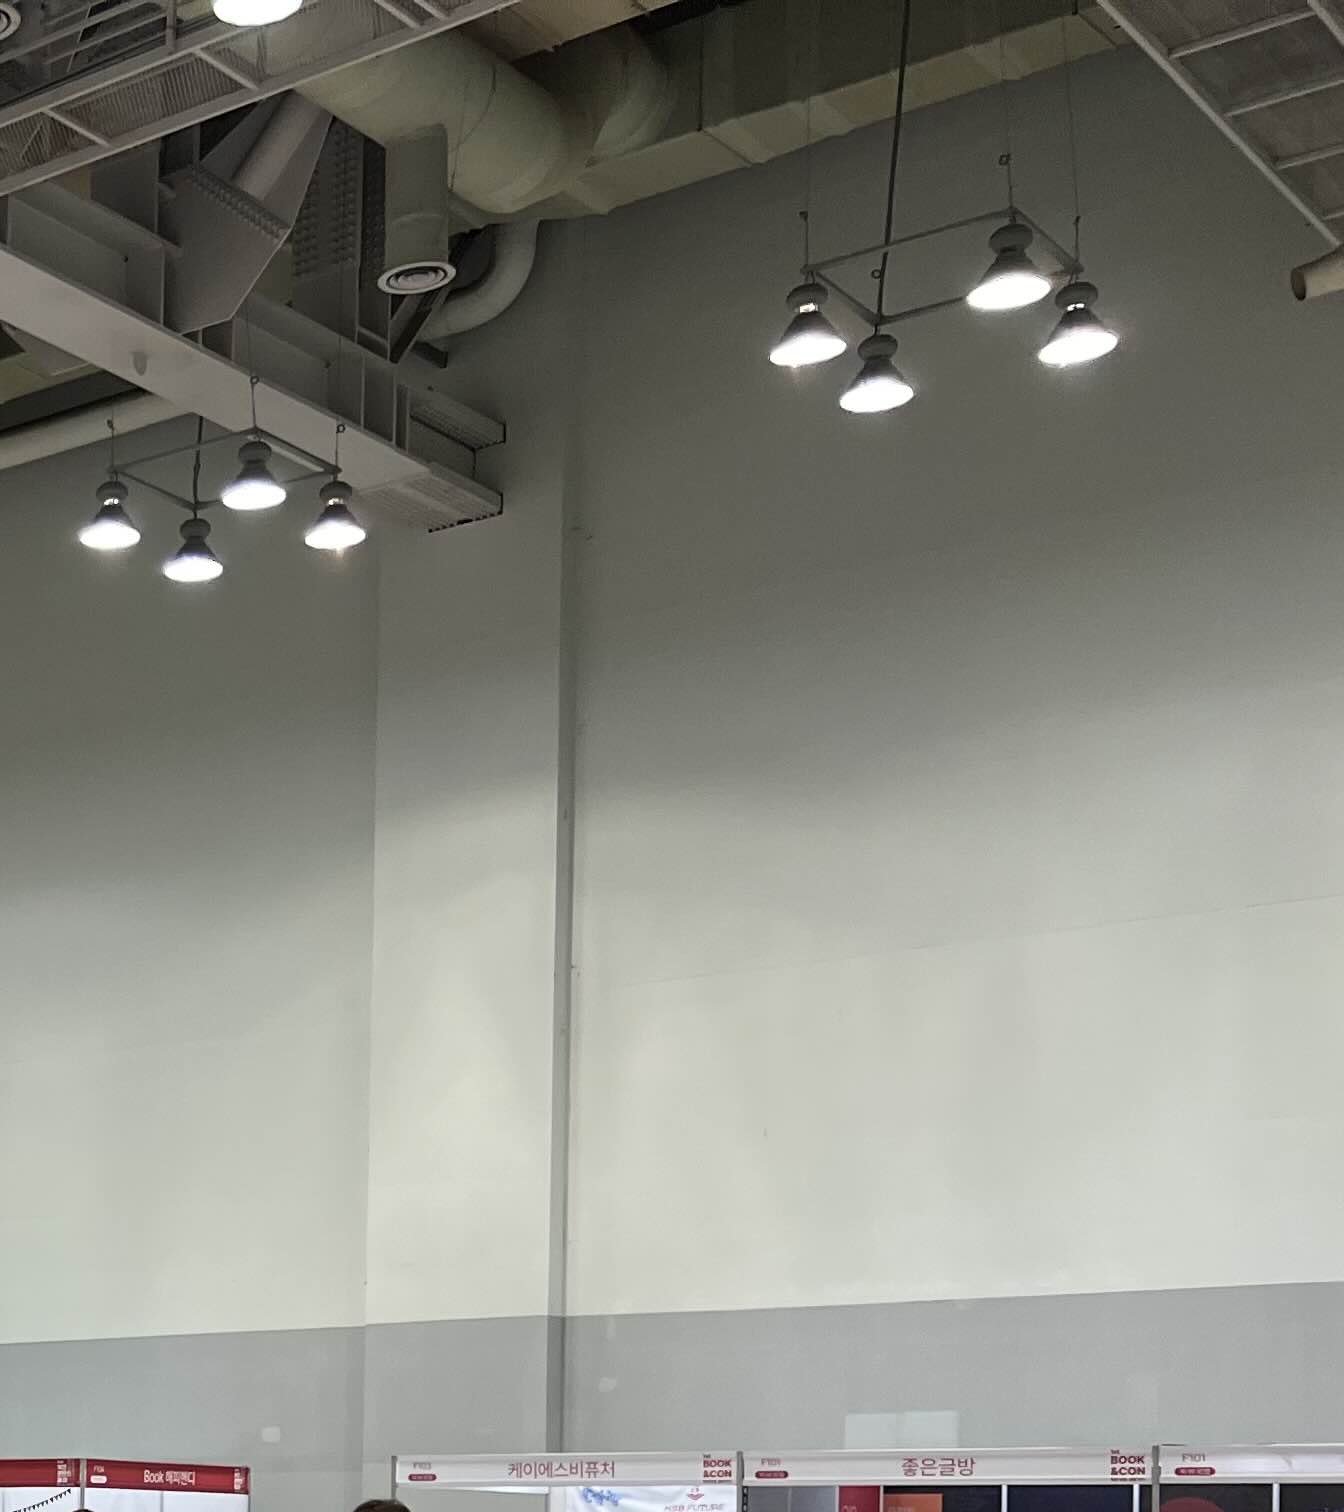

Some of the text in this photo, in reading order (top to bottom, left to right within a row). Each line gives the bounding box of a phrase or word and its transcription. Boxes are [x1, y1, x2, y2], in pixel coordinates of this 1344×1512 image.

[703, 1459, 733, 1468] BOOK
[1110, 1455, 1145, 1465] BOOK
[508, 1461, 616, 1479] 케이에스비퓨처
[901, 1457, 977, 1478] 좋은글방
[1110, 1466, 1146, 1476] &CON
[143, 1469, 165, 1484] Book
[703, 1469, 733, 1479] &CON
